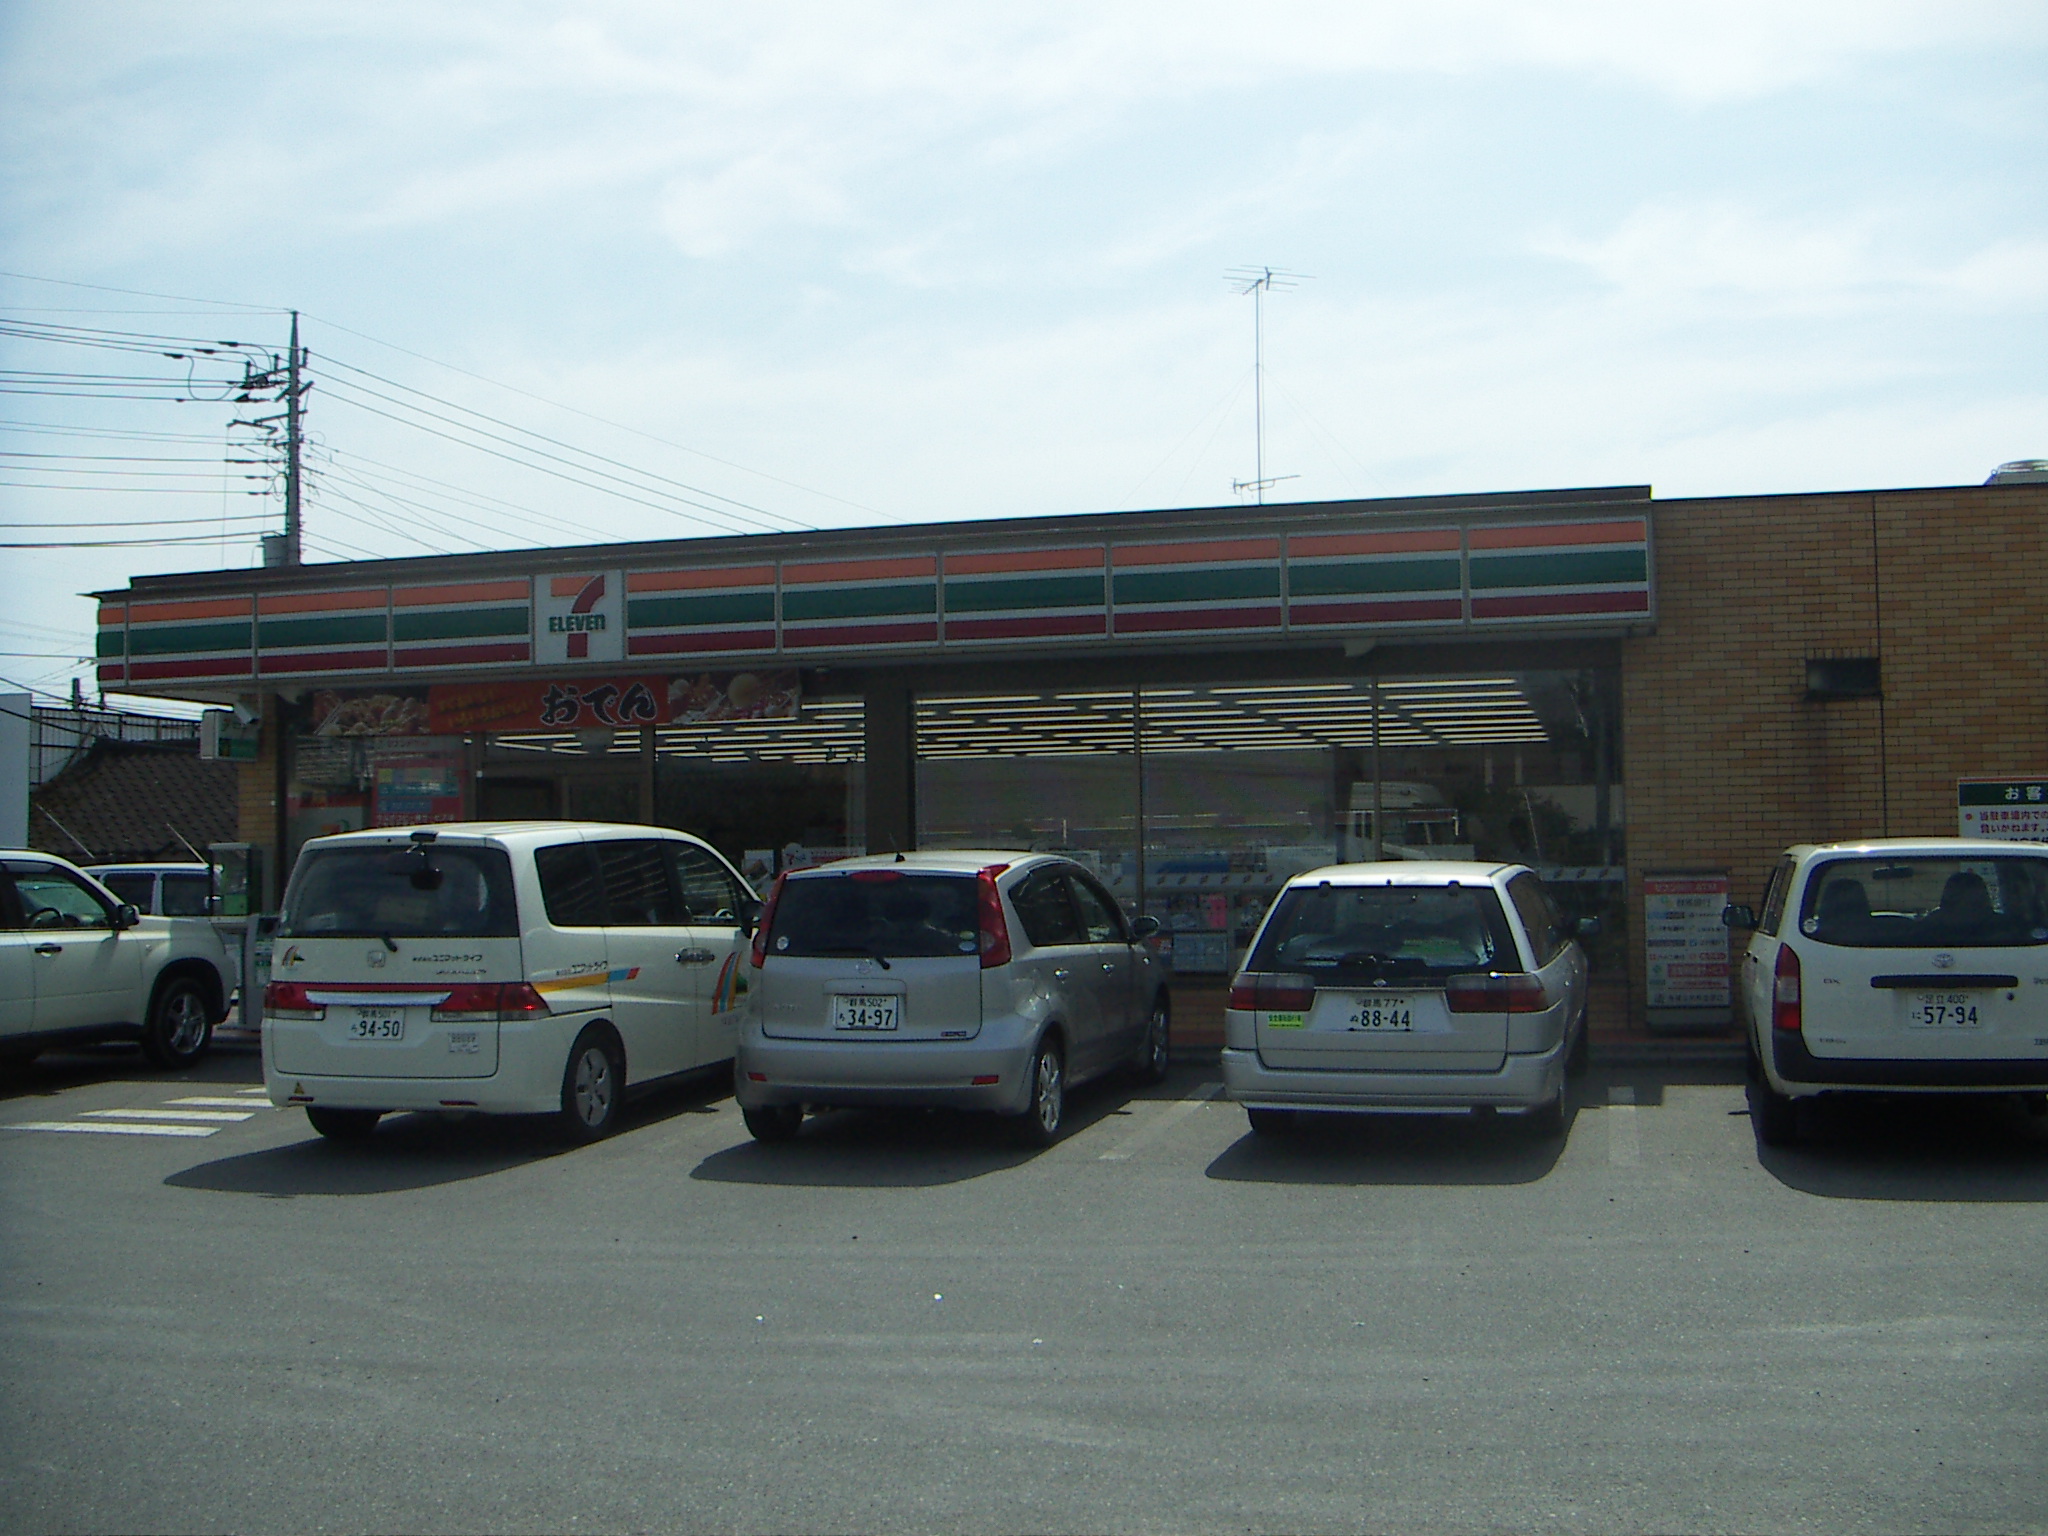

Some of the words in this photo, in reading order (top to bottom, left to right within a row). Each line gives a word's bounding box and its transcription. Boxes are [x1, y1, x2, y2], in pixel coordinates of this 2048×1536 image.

[540, 681, 658, 726] おでん
[867, 997, 883, 1007] 502
[1383, 998, 1398, 1007] 77
[1947, 994, 1966, 1004] 400
[847, 1009, 894, 1026] 34-97
[1360, 1010, 1411, 1027] 88-44
[1923, 1006, 1978, 1025] 57-94
[359, 1020, 401, 1037] 94-50
